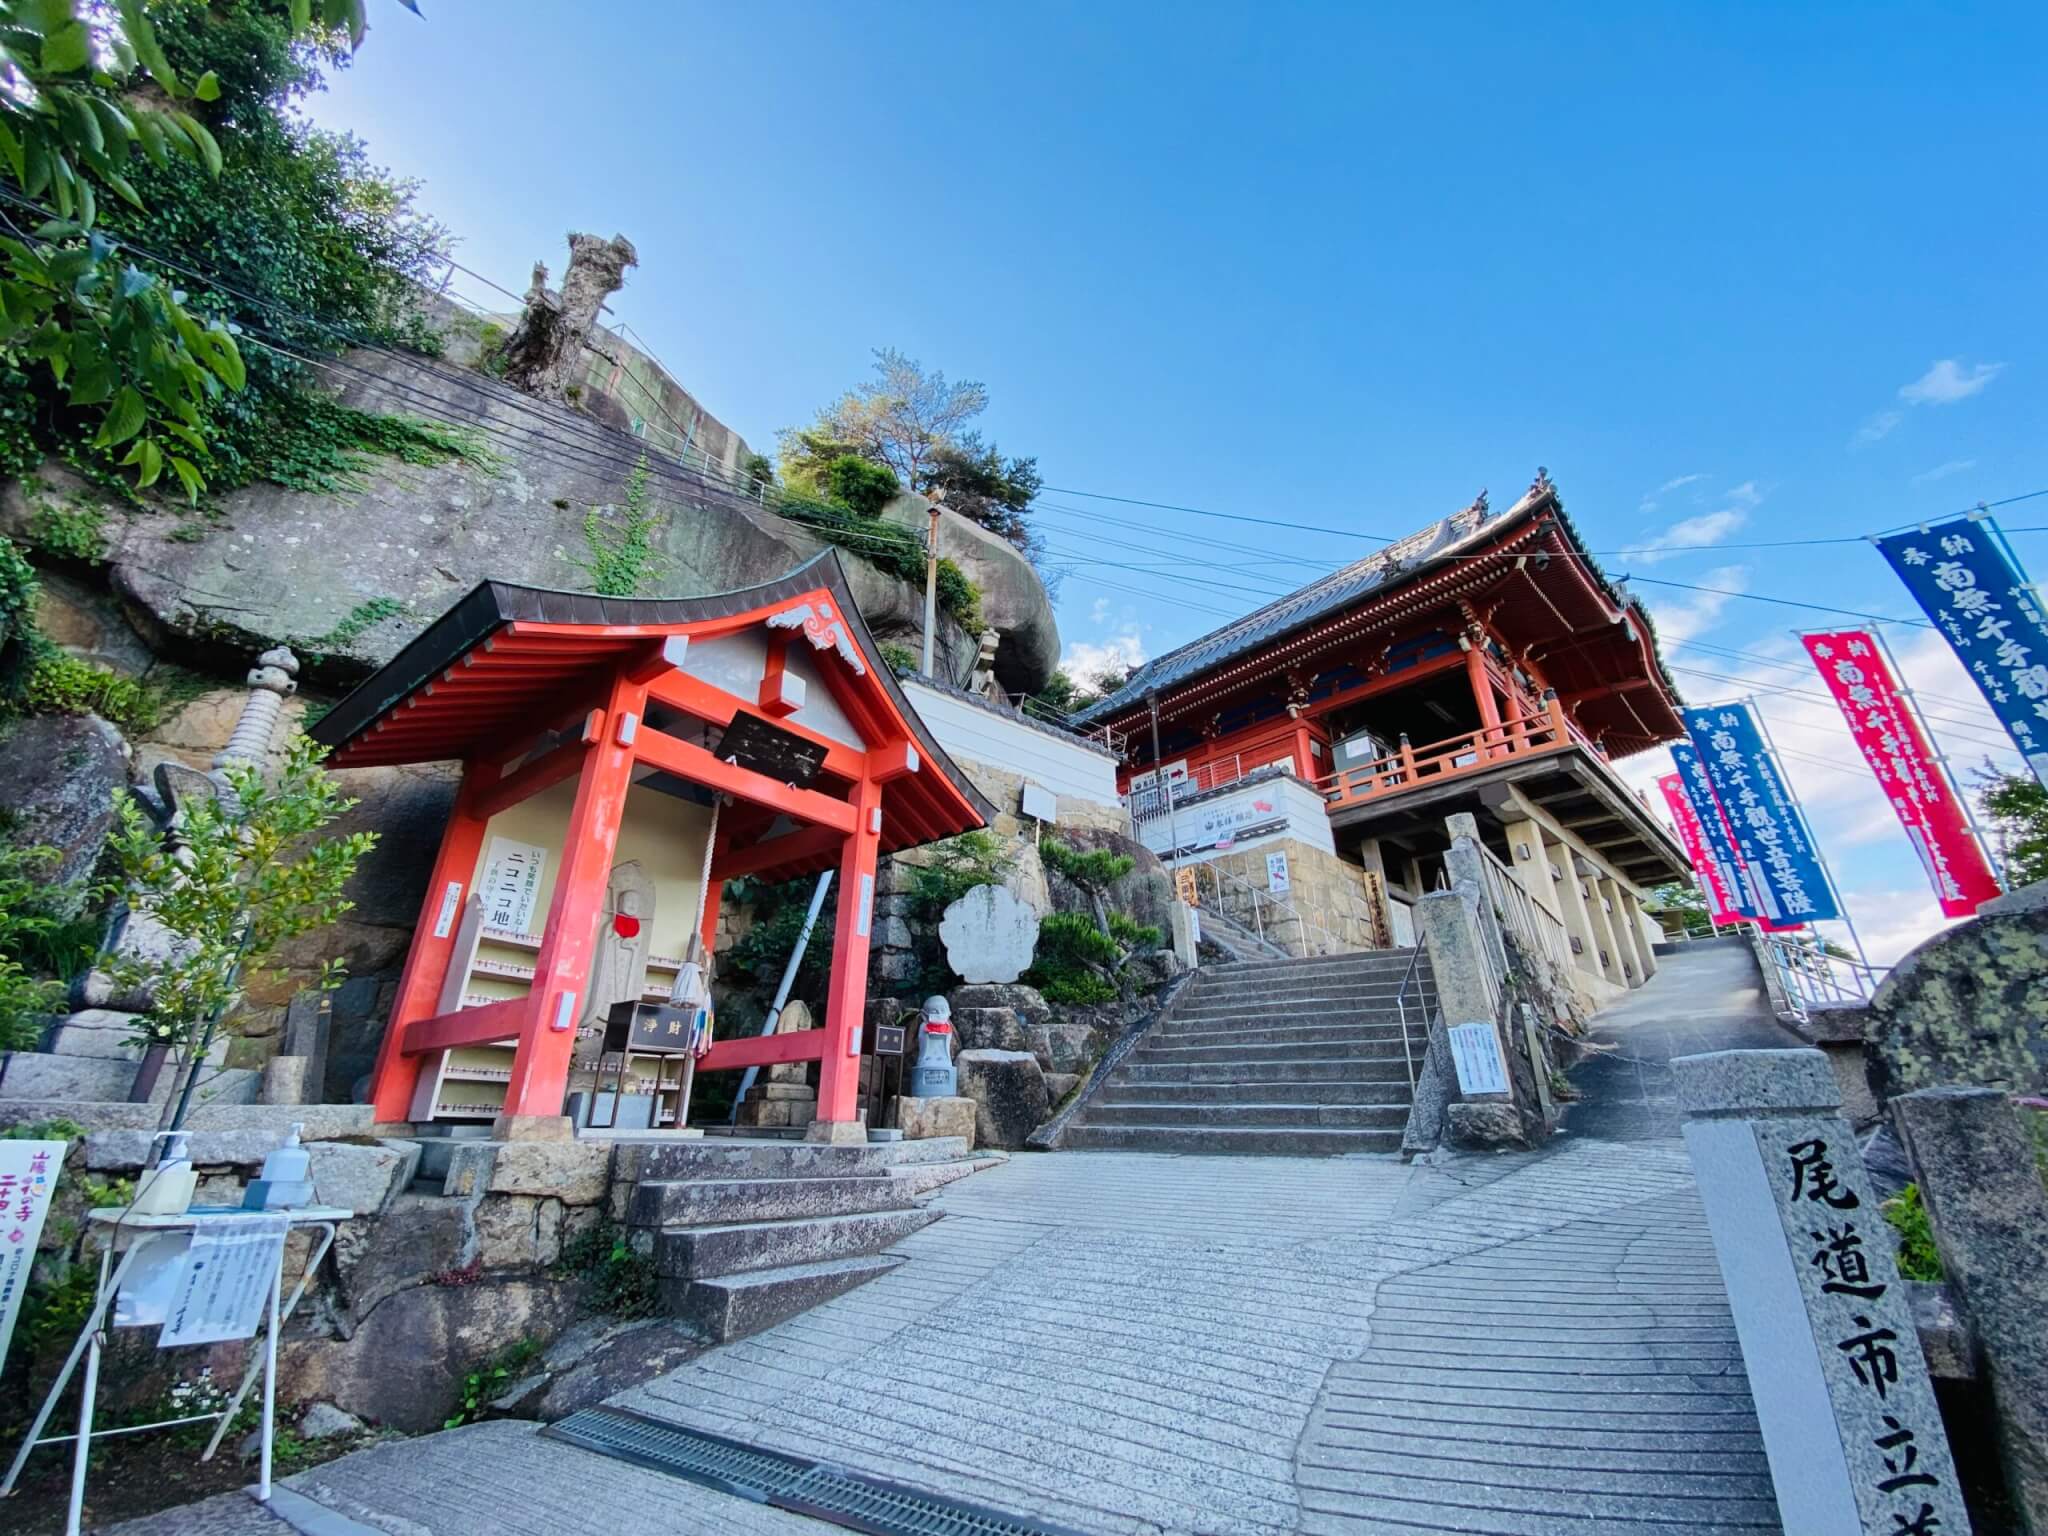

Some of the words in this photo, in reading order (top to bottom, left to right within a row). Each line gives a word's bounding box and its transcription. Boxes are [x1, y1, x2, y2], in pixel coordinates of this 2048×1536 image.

[1902, 534, 1976, 566] 奉納
[1814, 640, 1870, 659] 奉納
[1695, 712, 1739, 731] 奉納
[1710, 730, 1816, 915] 南無千手観世音菩薩
